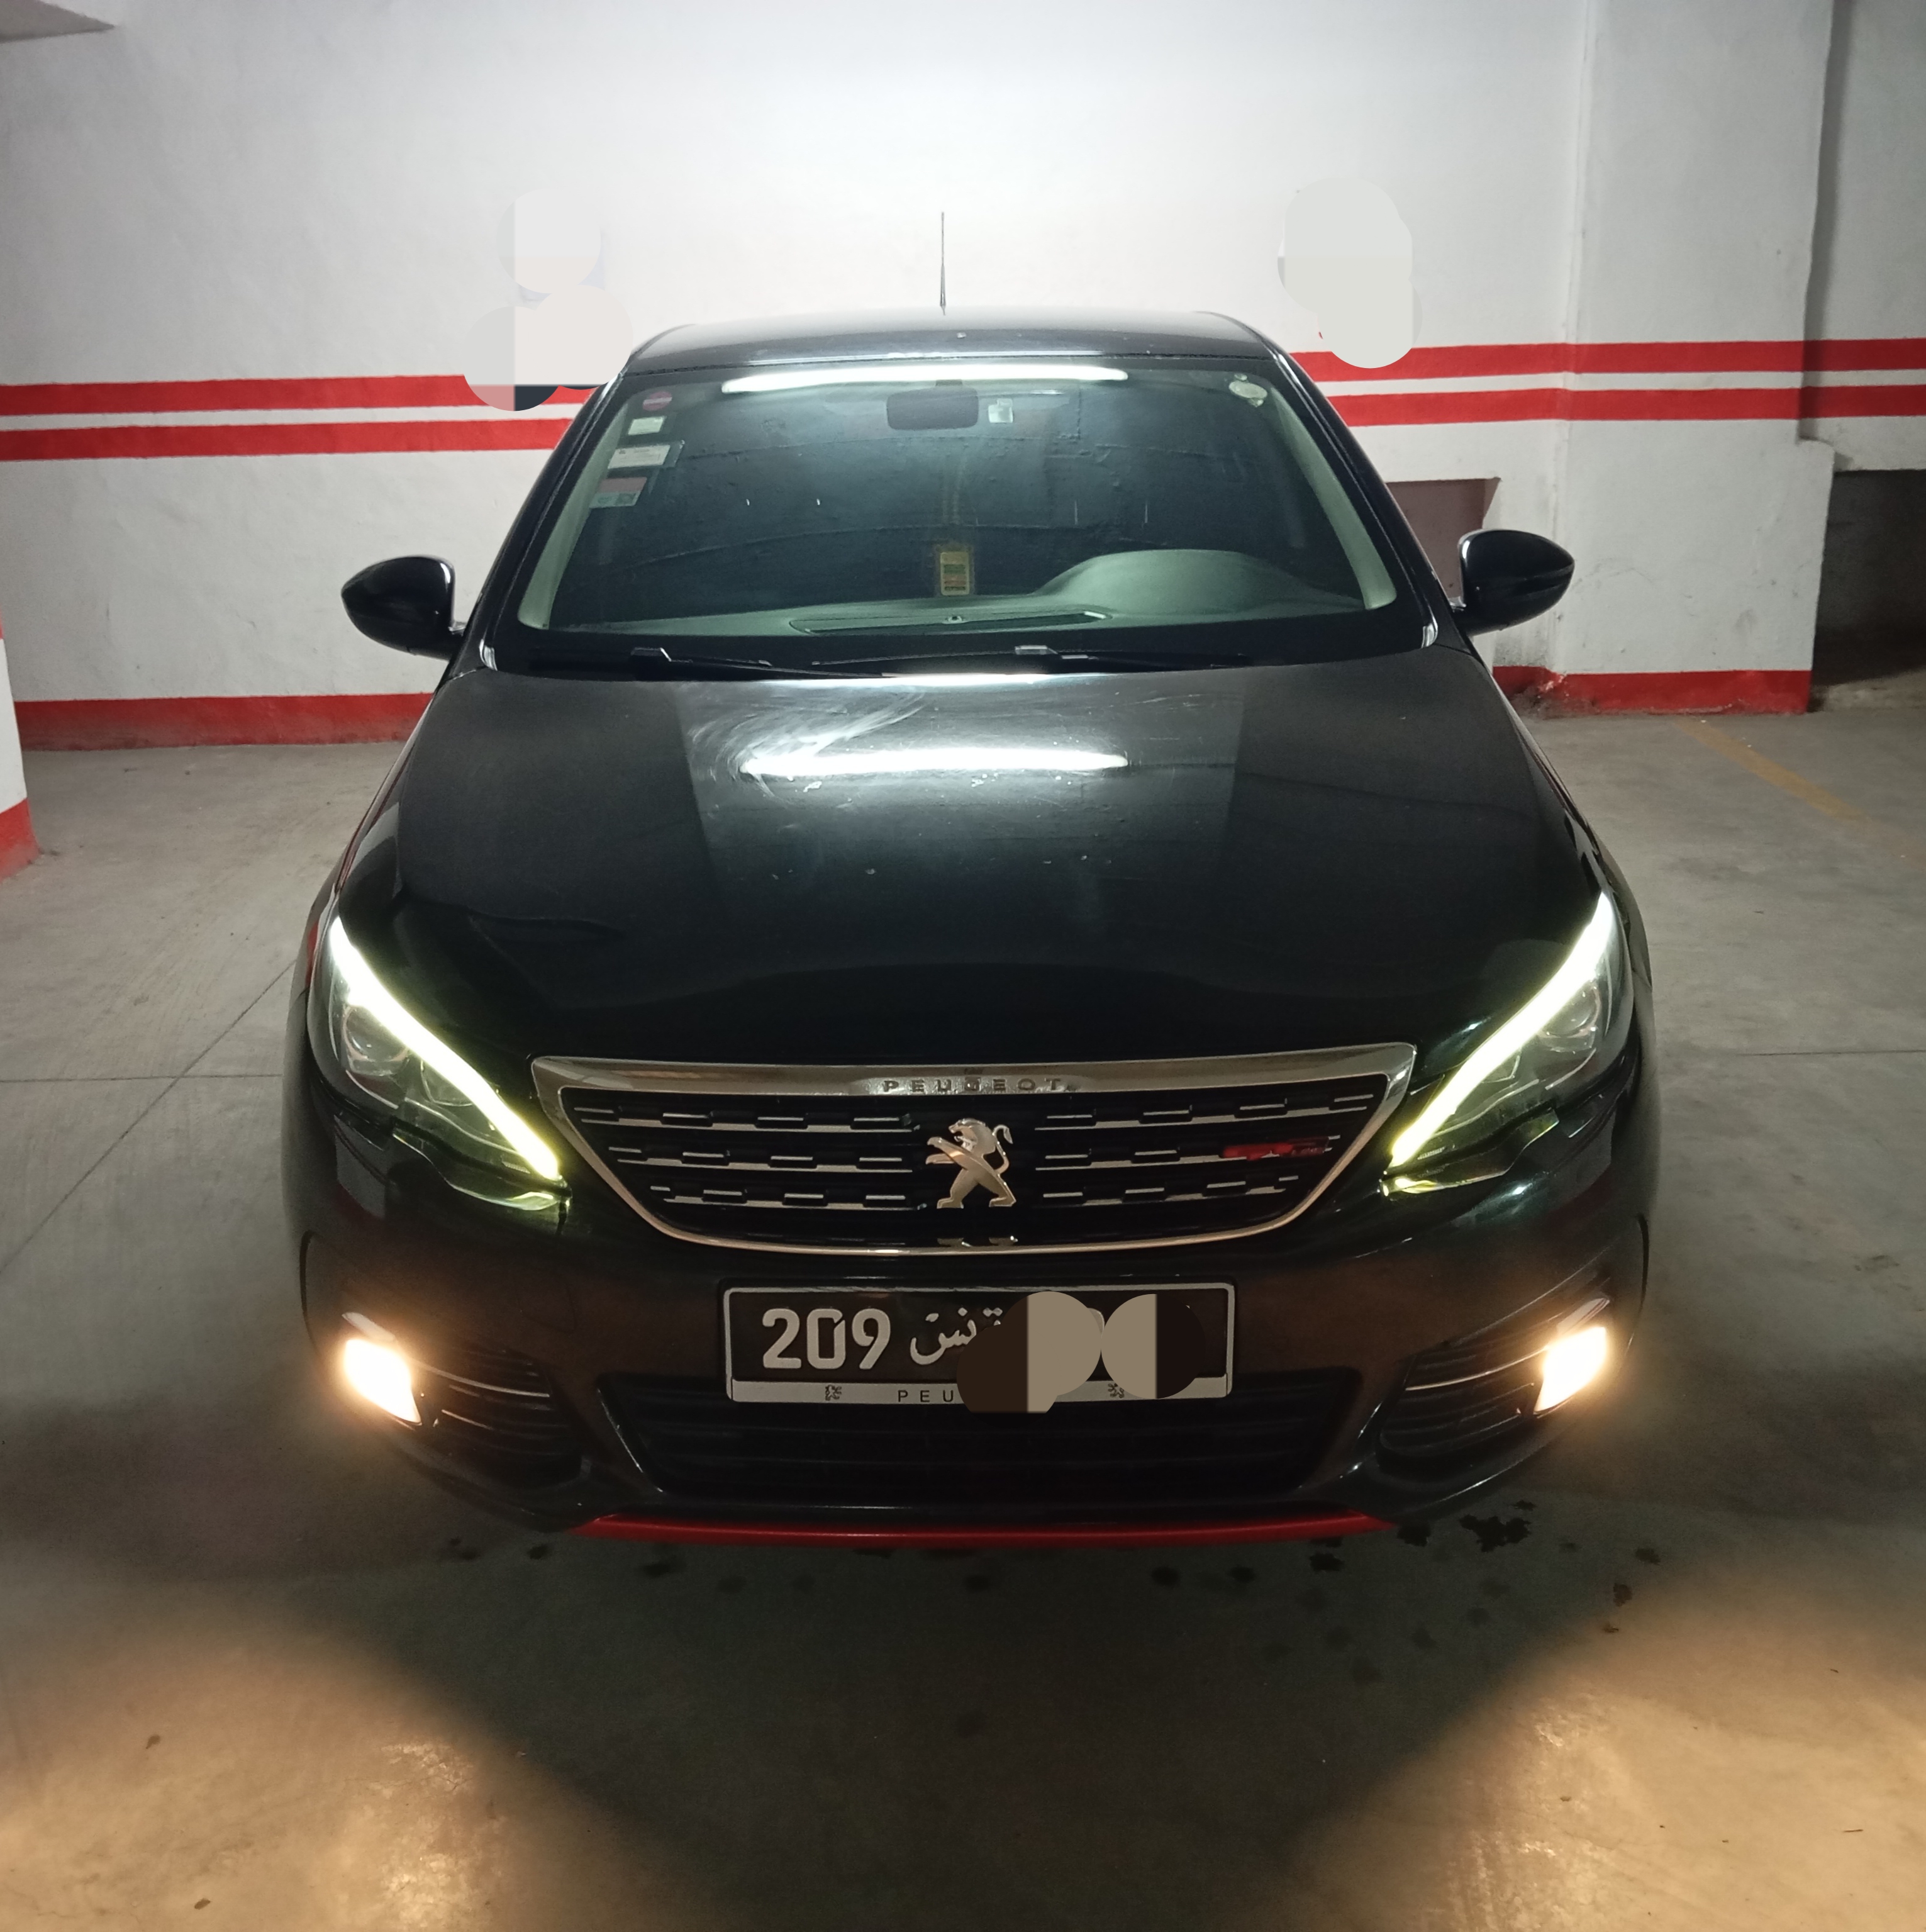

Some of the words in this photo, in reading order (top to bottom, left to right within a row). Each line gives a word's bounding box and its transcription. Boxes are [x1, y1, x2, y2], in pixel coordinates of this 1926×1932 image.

[882, 1078, 1061, 1093] PEUGEOT
[762, 1308, 891, 1370] 209
[898, 1390, 954, 1403] PEU
